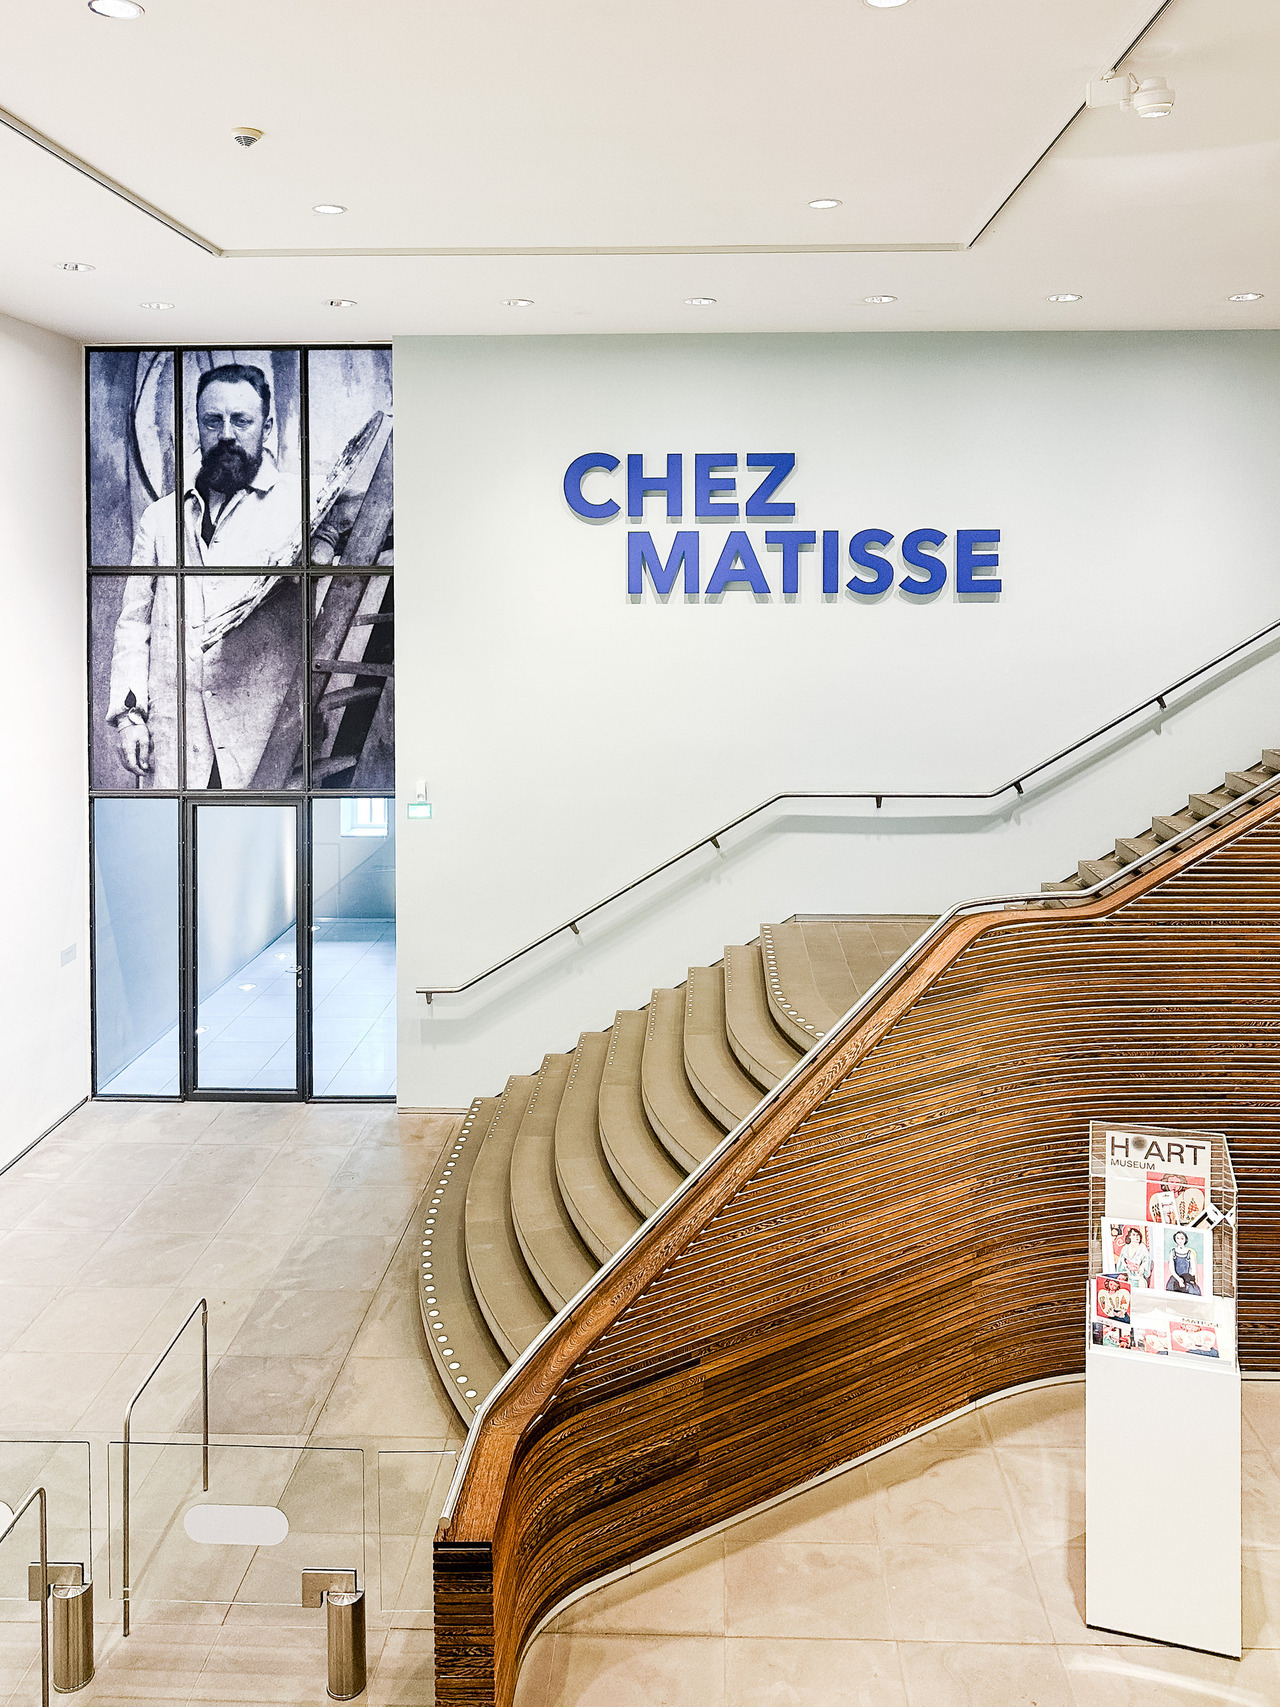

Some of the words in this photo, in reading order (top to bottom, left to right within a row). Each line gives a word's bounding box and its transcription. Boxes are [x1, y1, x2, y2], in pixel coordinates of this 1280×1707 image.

[563, 452, 796, 518] CHEZ
[627, 528, 1002, 595] MATISSE
[1110, 1158, 1155, 1170] MUSEUM
